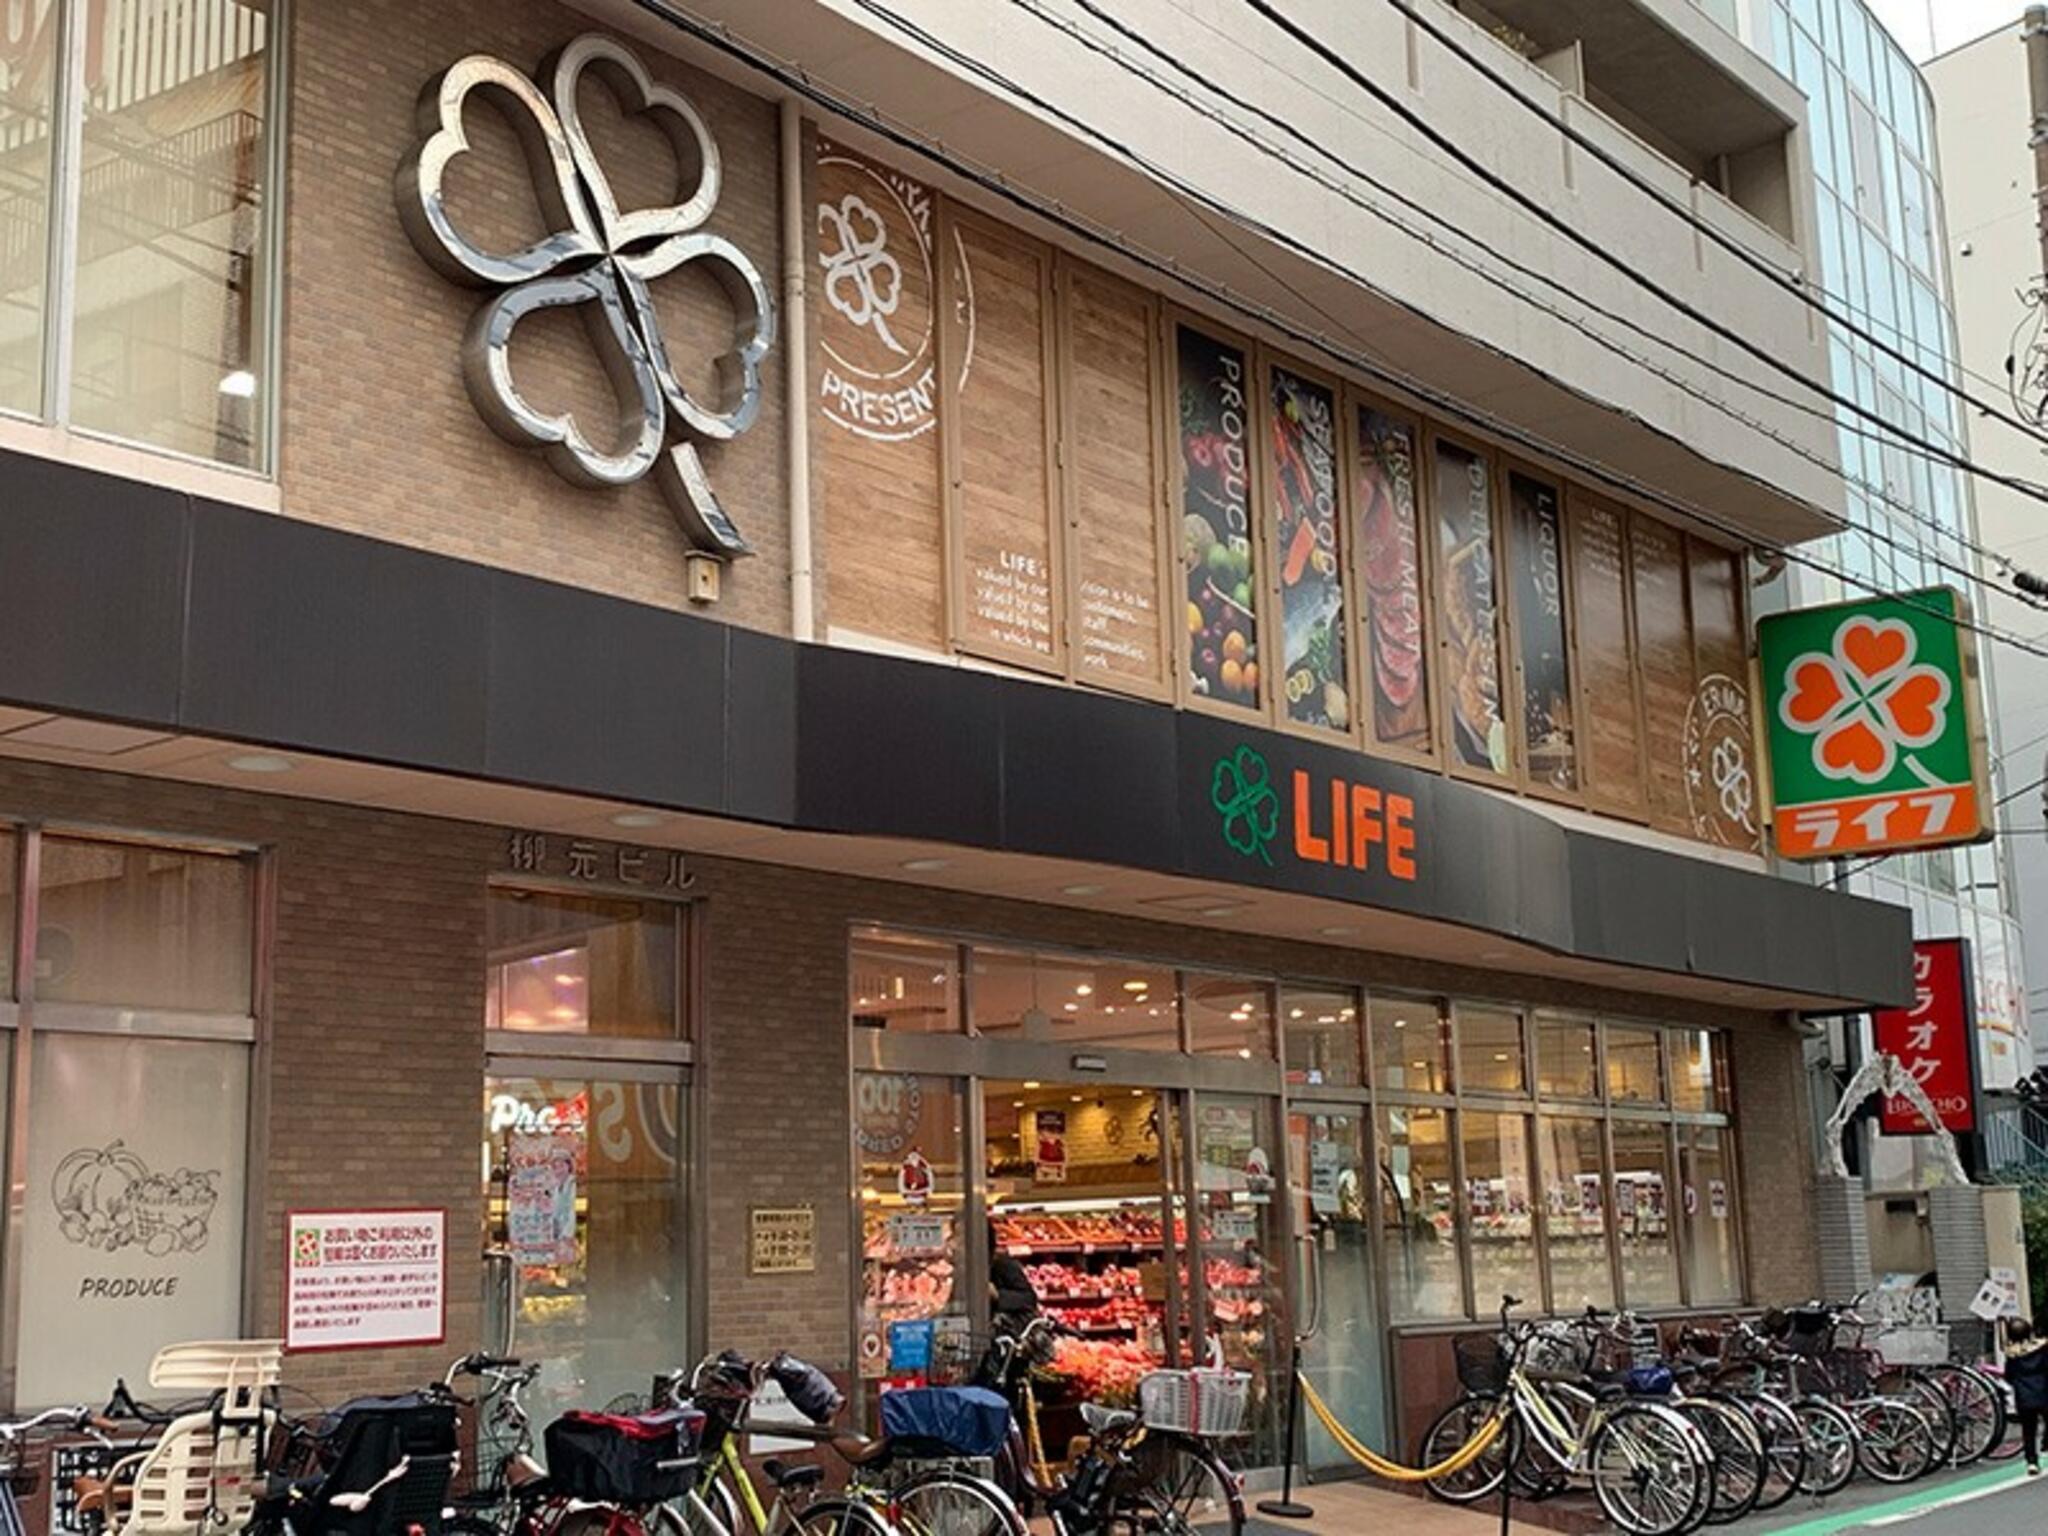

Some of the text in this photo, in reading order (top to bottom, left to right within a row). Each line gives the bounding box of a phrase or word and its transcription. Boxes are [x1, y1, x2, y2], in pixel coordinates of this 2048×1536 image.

[1219, 355, 1249, 556] PRODUCE
[1537, 492, 1560, 617] LIQUOR
[1294, 769, 1416, 881] LIFE
[1795, 793, 1956, 849] ライフ
[79, 1277, 179, 1299] PRODUCE
